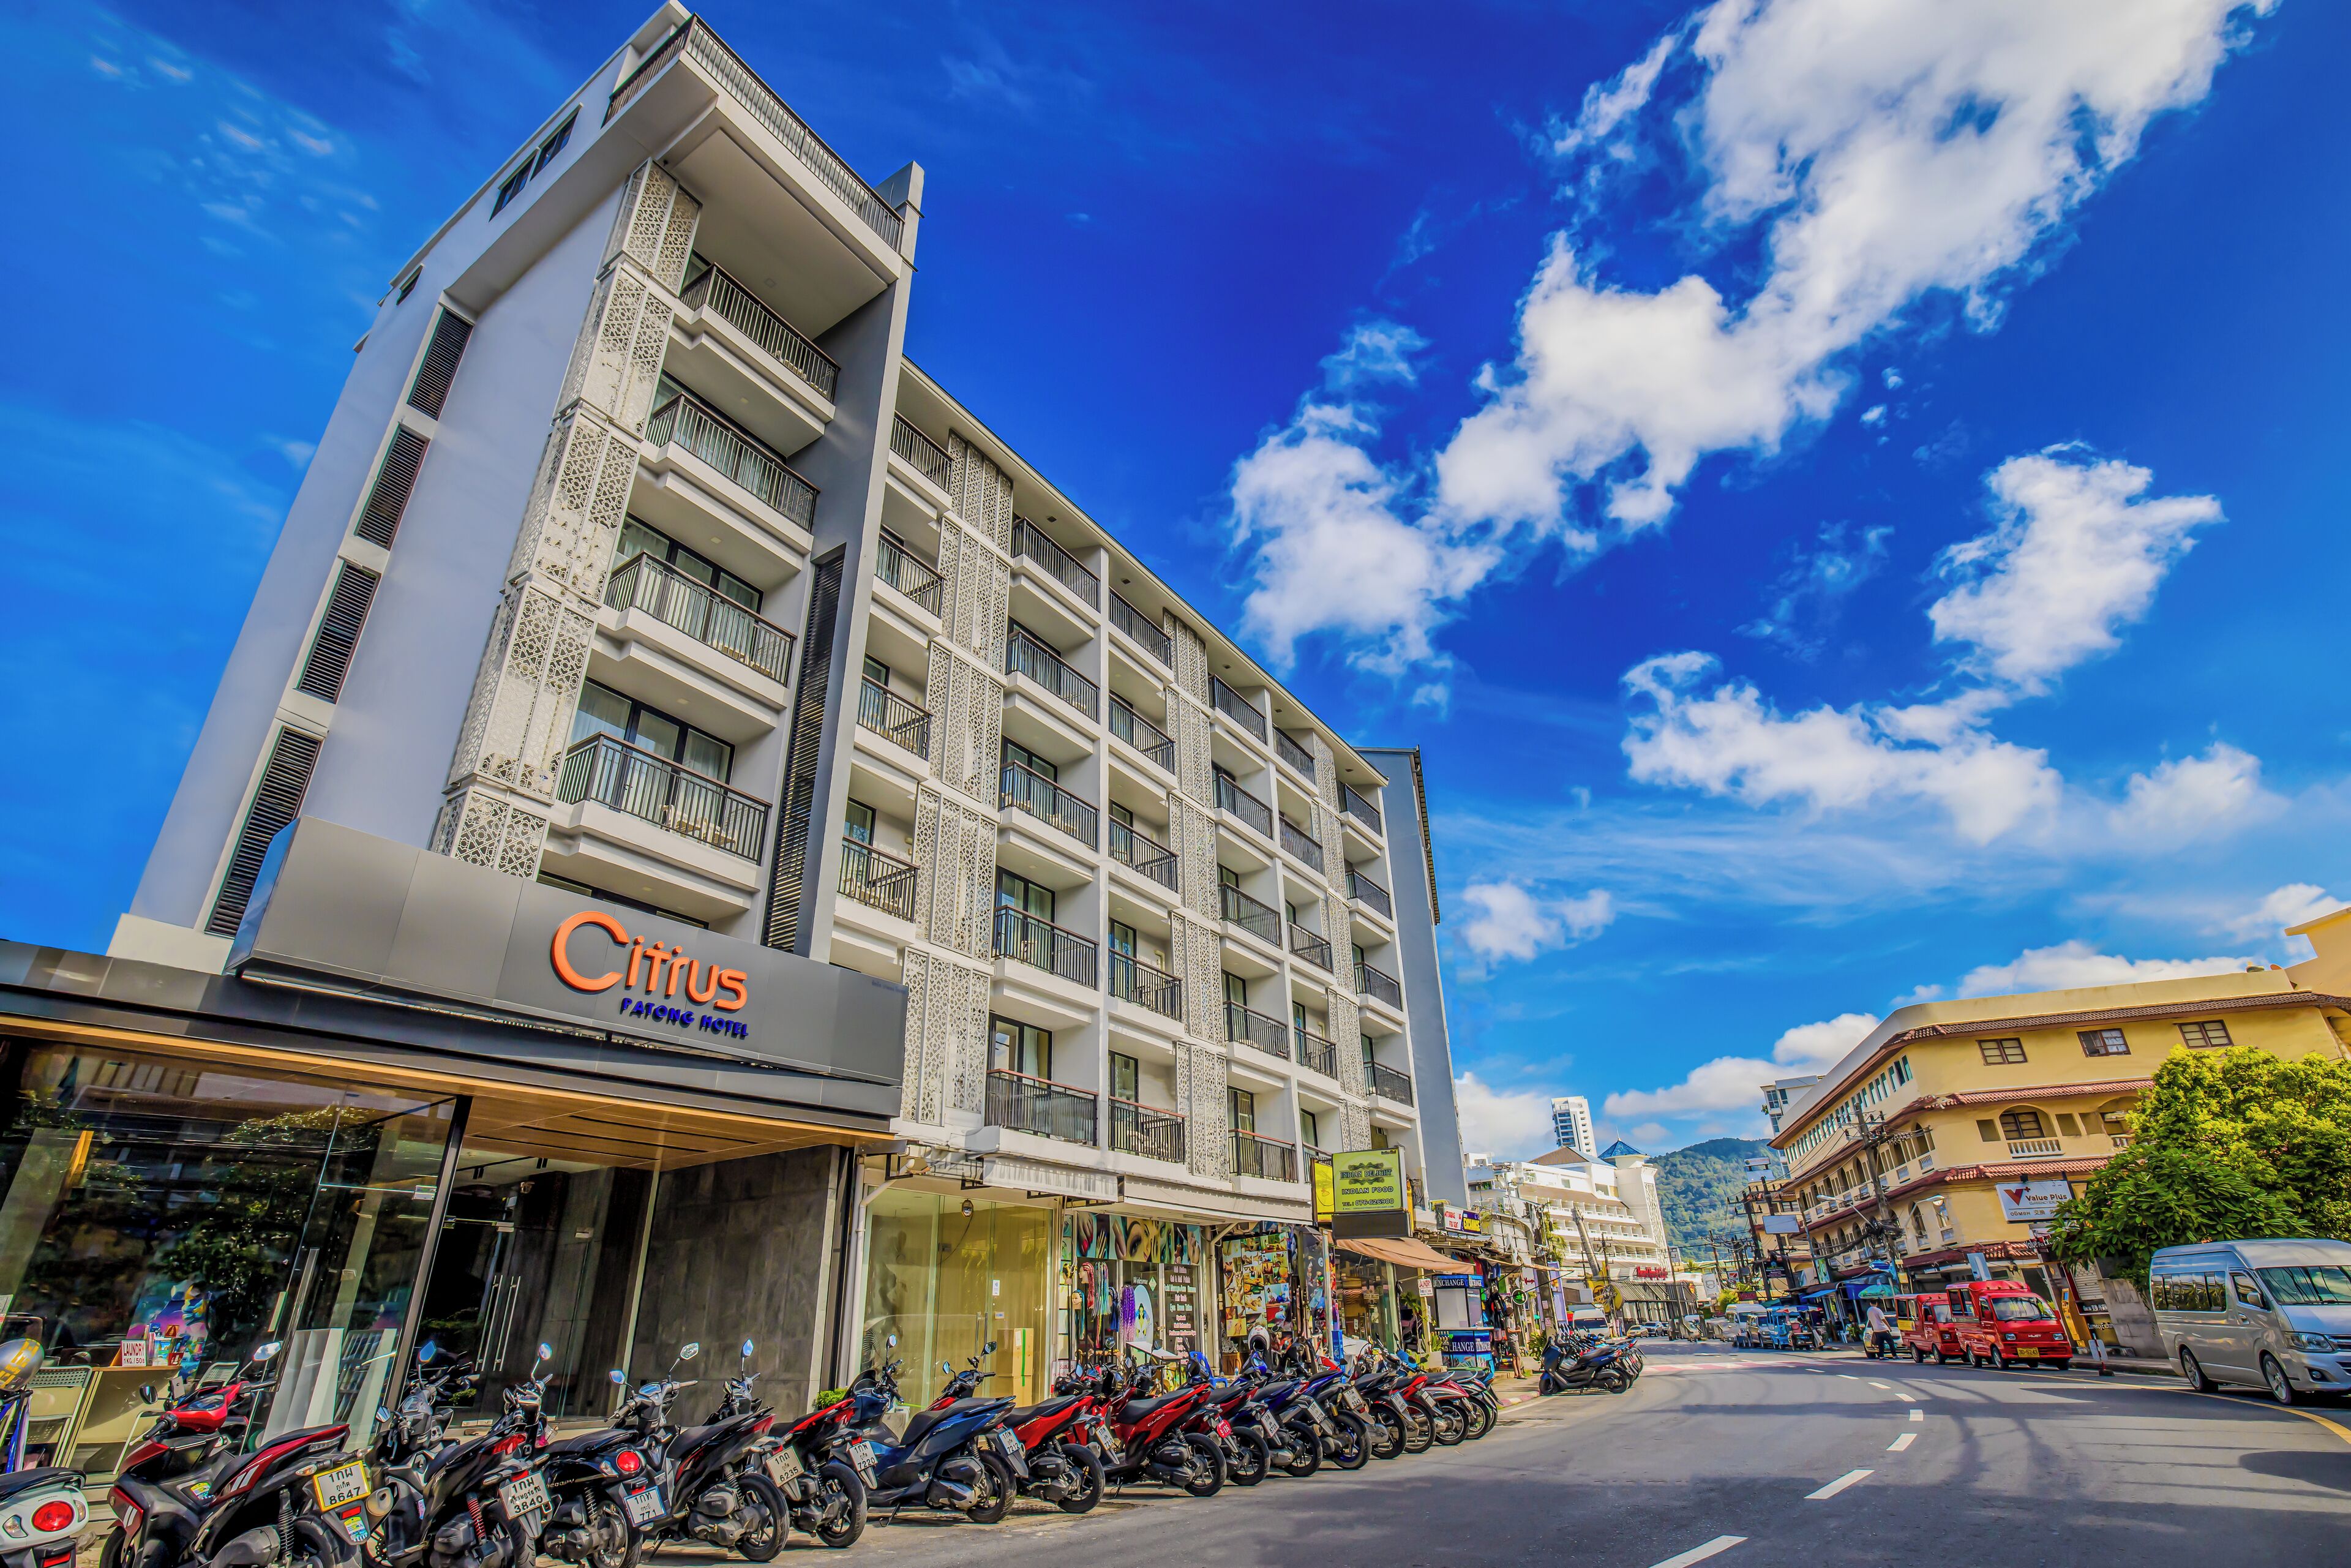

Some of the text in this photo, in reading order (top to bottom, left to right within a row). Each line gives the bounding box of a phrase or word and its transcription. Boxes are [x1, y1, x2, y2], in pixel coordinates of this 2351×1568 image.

[552, 911, 748, 1010] Citrus
[621, 997, 749, 1037] PATONG HOTEL
[1435, 1278, 1464, 1287] EXCHANGE
[124, 1343, 144, 1356] LAUNDRY
[1007, 1442, 1019, 1454] 7212
[857, 1457, 876, 1470] 7220
[779, 1466, 798, 1482] 6235
[329, 1486, 361, 1505] 8647
[514, 1495, 543, 1513] 3840
[639, 1509, 657, 1521] 771
